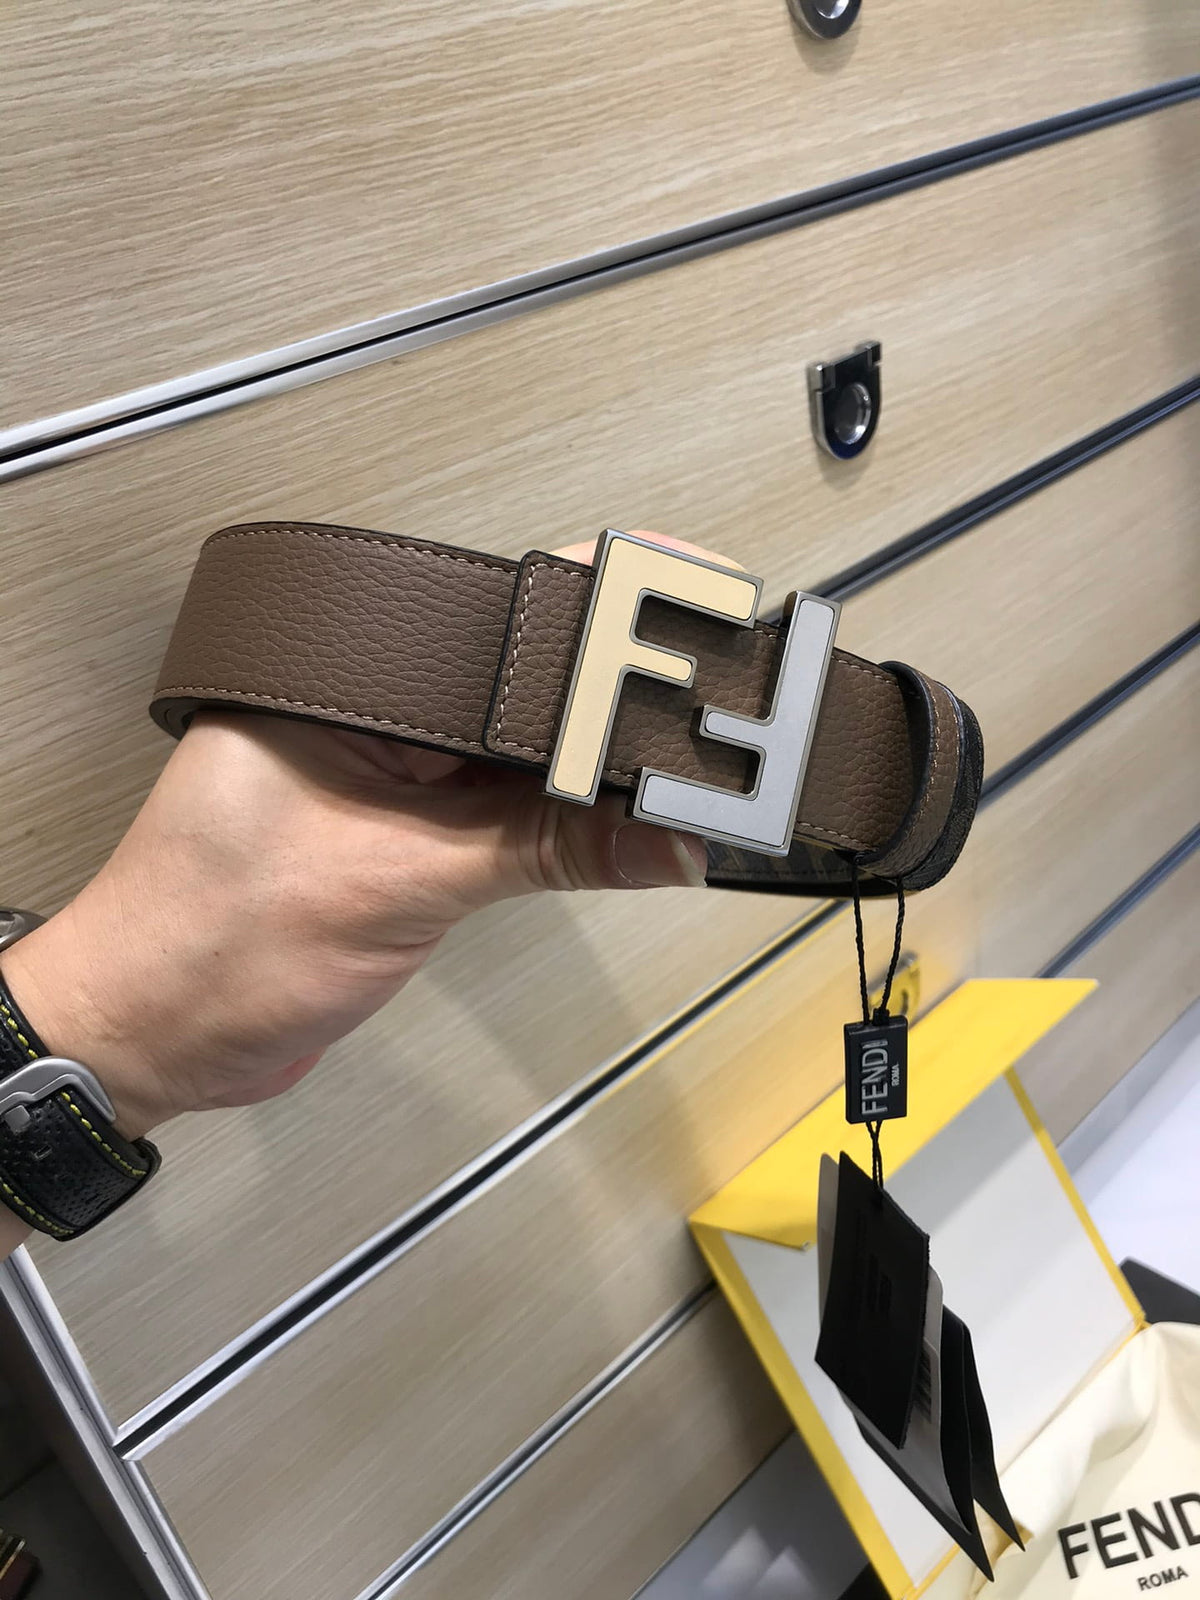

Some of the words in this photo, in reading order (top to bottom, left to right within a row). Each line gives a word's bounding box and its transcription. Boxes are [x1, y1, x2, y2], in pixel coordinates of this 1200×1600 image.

[861, 1039, 888, 1115] FENDI
[891, 1063, 900, 1087] ROMA
[1136, 1565, 1189, 1592] ROMA
